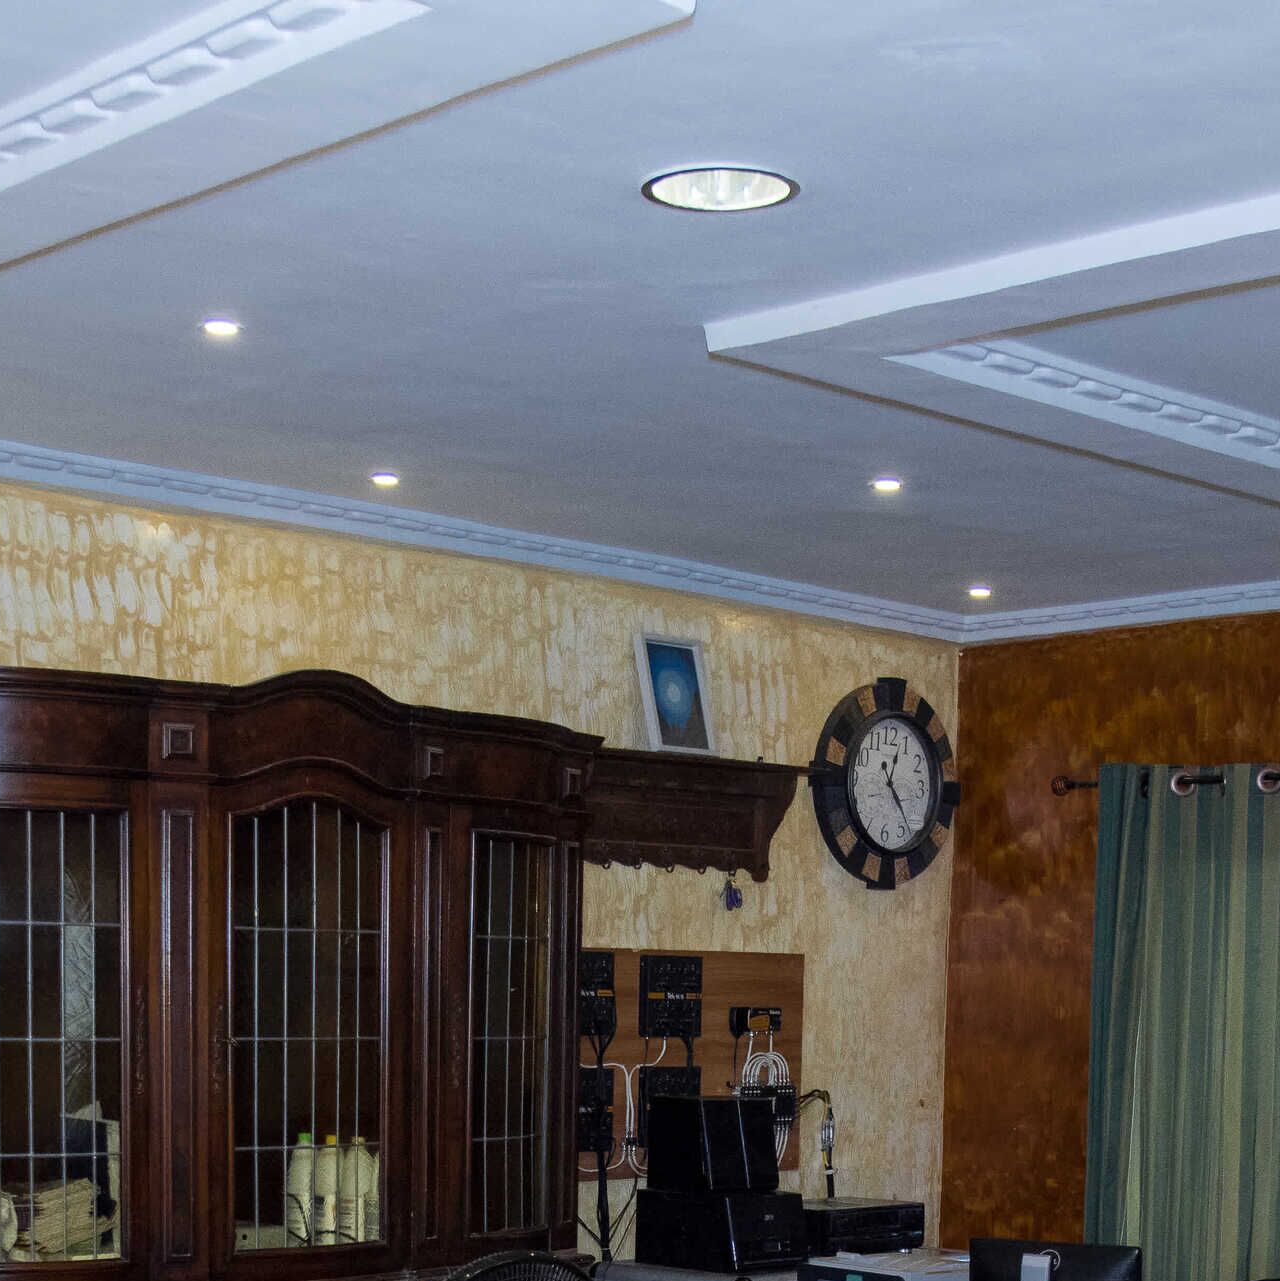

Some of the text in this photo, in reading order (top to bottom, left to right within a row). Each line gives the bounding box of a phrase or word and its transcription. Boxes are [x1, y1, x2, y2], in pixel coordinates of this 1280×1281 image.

[869, 730, 880, 751] 11
[881, 726, 897, 746] 12
[903, 736, 908, 755] 1
[913, 754, 922, 774] 2
[915, 780, 925, 800] 3
[880, 823, 889, 843] 6
[896, 822, 906, 839] 5
